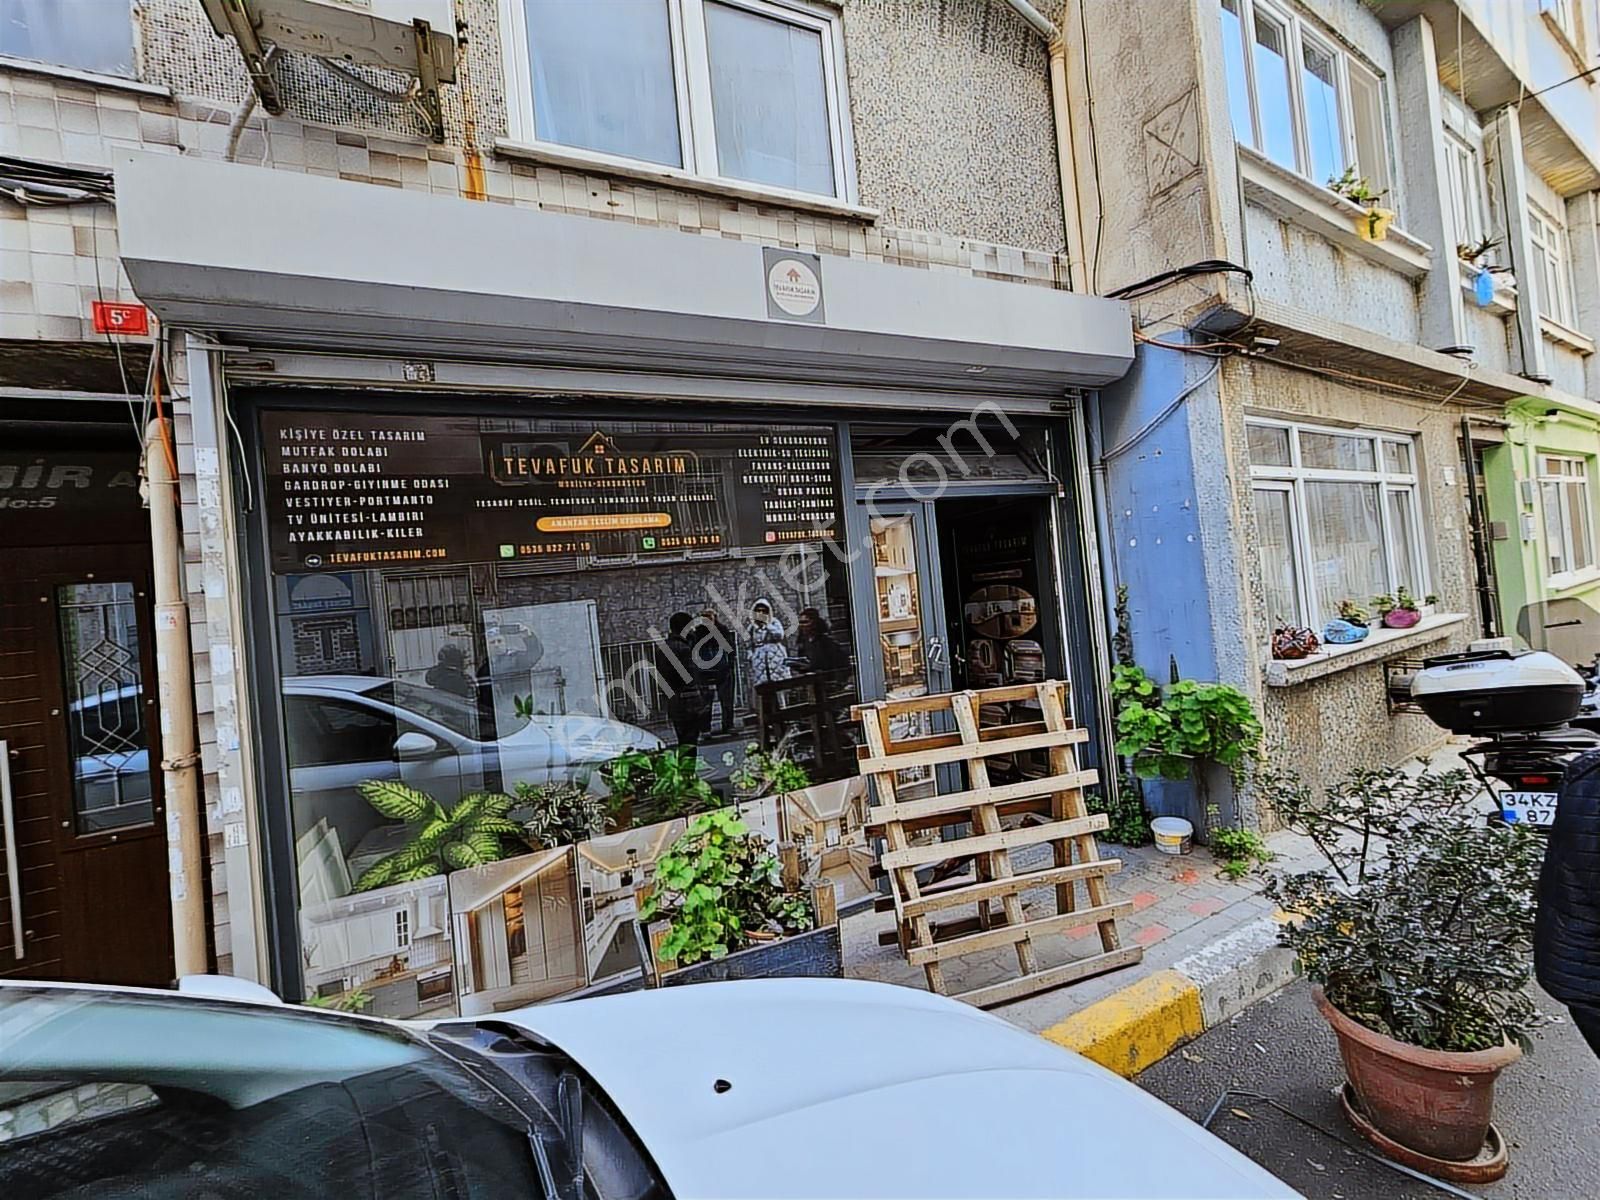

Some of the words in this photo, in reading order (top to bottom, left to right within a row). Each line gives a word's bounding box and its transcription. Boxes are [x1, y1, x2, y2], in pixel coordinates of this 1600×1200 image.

[279, 427, 326, 441] KİŞİYE
[332, 428, 365, 440] ÖZEL
[370, 429, 425, 441] TASARIM
[281, 446, 336, 457] MUTFAK
[341, 446, 389, 457] DOLABI
[282, 462, 328, 474] BANYO
[334, 462, 381, 474] DOLABI
[503, 457, 596, 475] TEVAFUK
[604, 456, 686, 474] TASARIM
[413, 478, 449, 489] ODASI
[287, 514, 304, 525] TV
[329, 549, 447, 563] TEVAFUKTASARIM.COM
